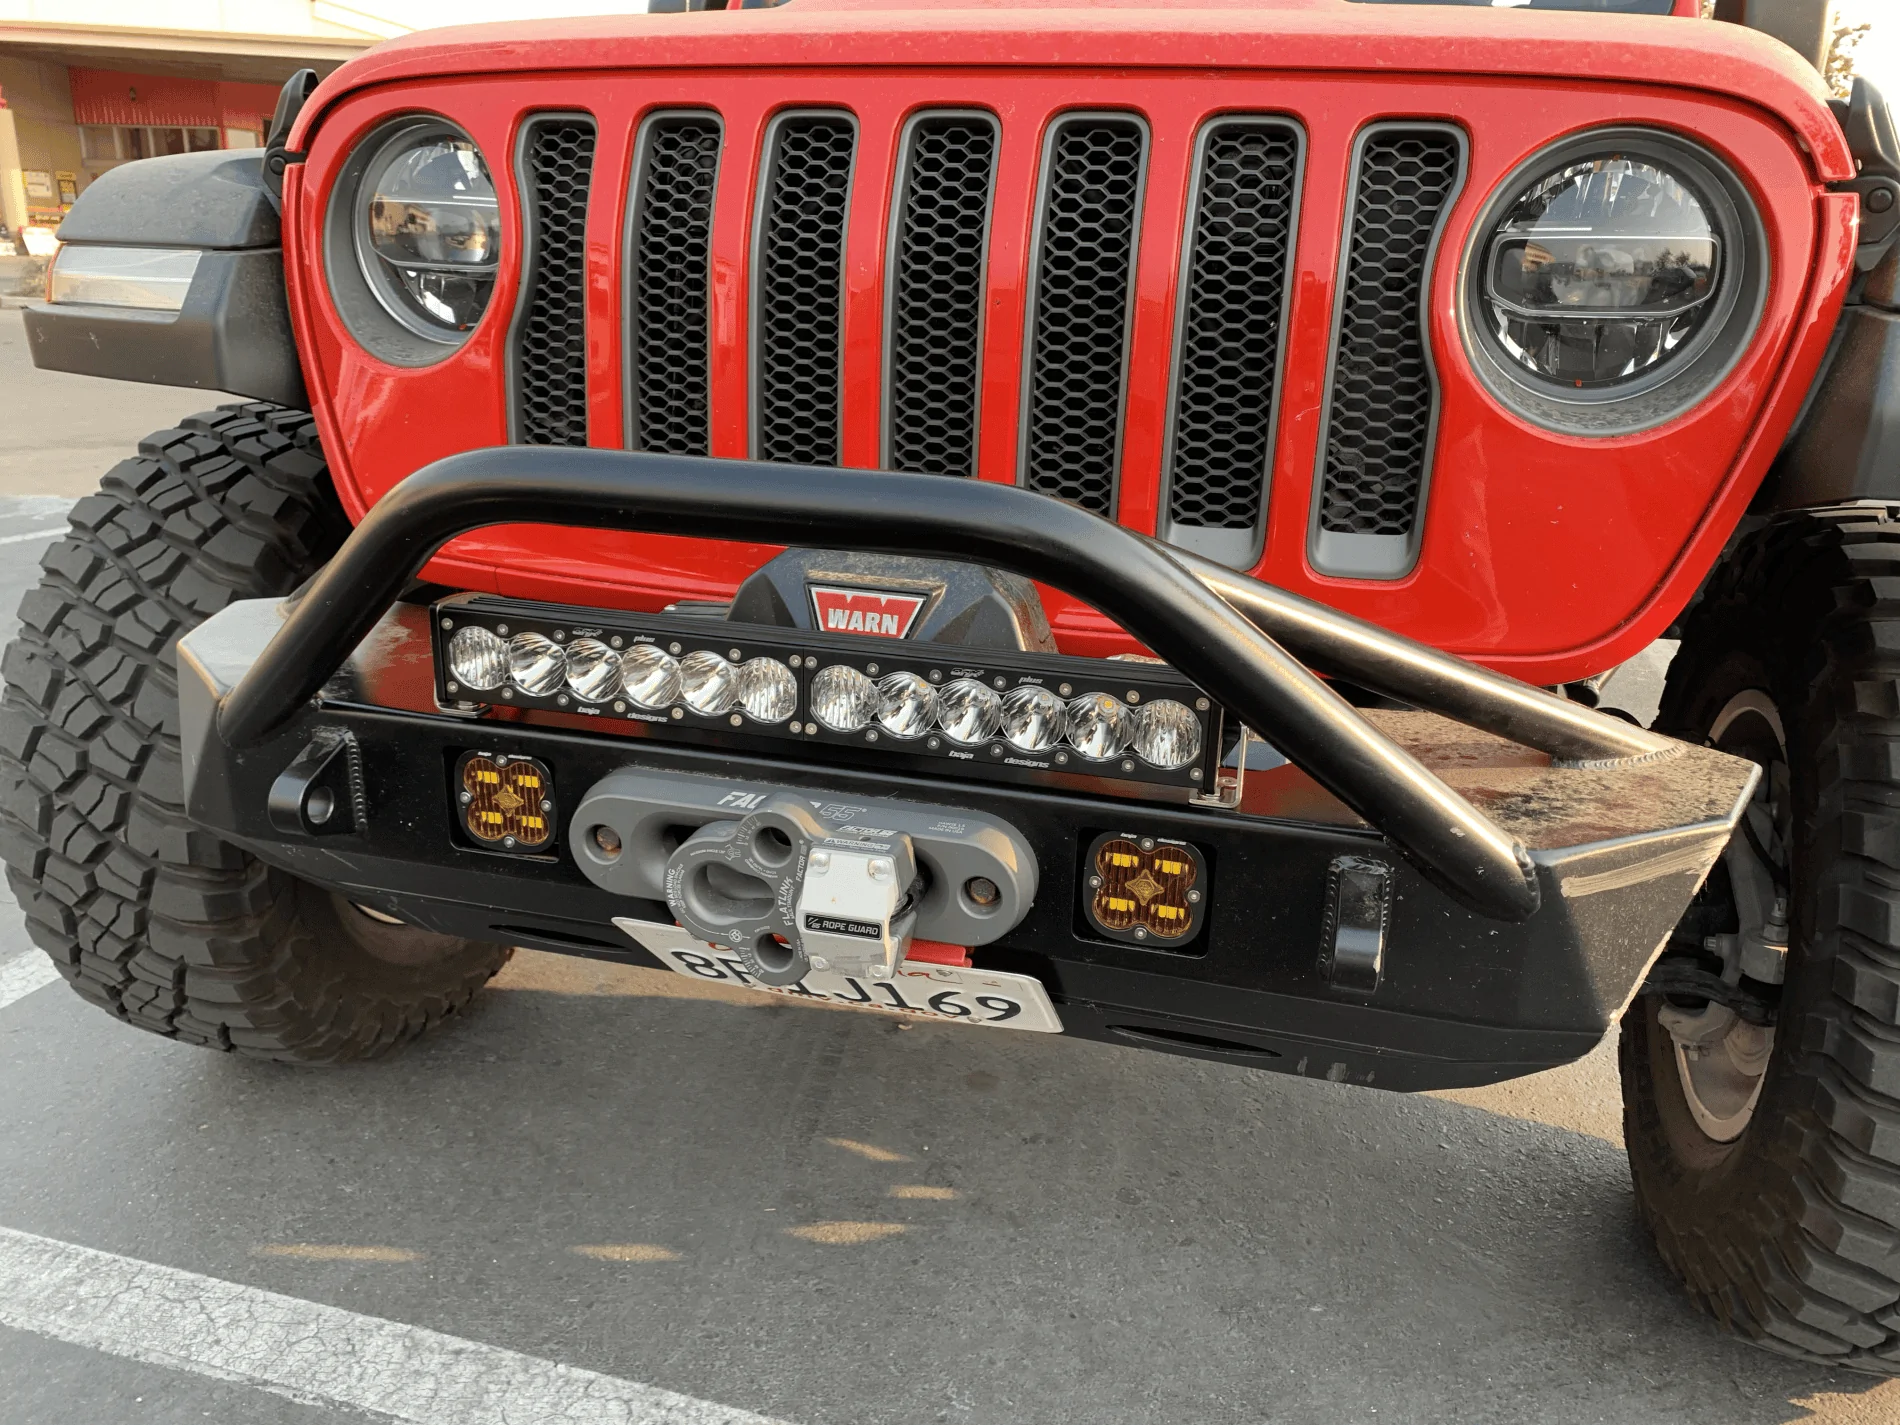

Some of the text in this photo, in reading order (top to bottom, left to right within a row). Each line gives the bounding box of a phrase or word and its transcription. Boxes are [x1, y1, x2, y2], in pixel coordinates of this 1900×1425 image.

[828, 608, 898, 635] WARN
[577, 706, 668, 723] baja designs
[948, 750, 1050, 769] baja designs
[796, 855, 807, 882] FACTOR
[666, 868, 676, 907] WARNING
[778, 876, 794, 926] FLATLINK
[822, 920, 846, 931] ROPE
[848, 924, 878, 936] GUARD
